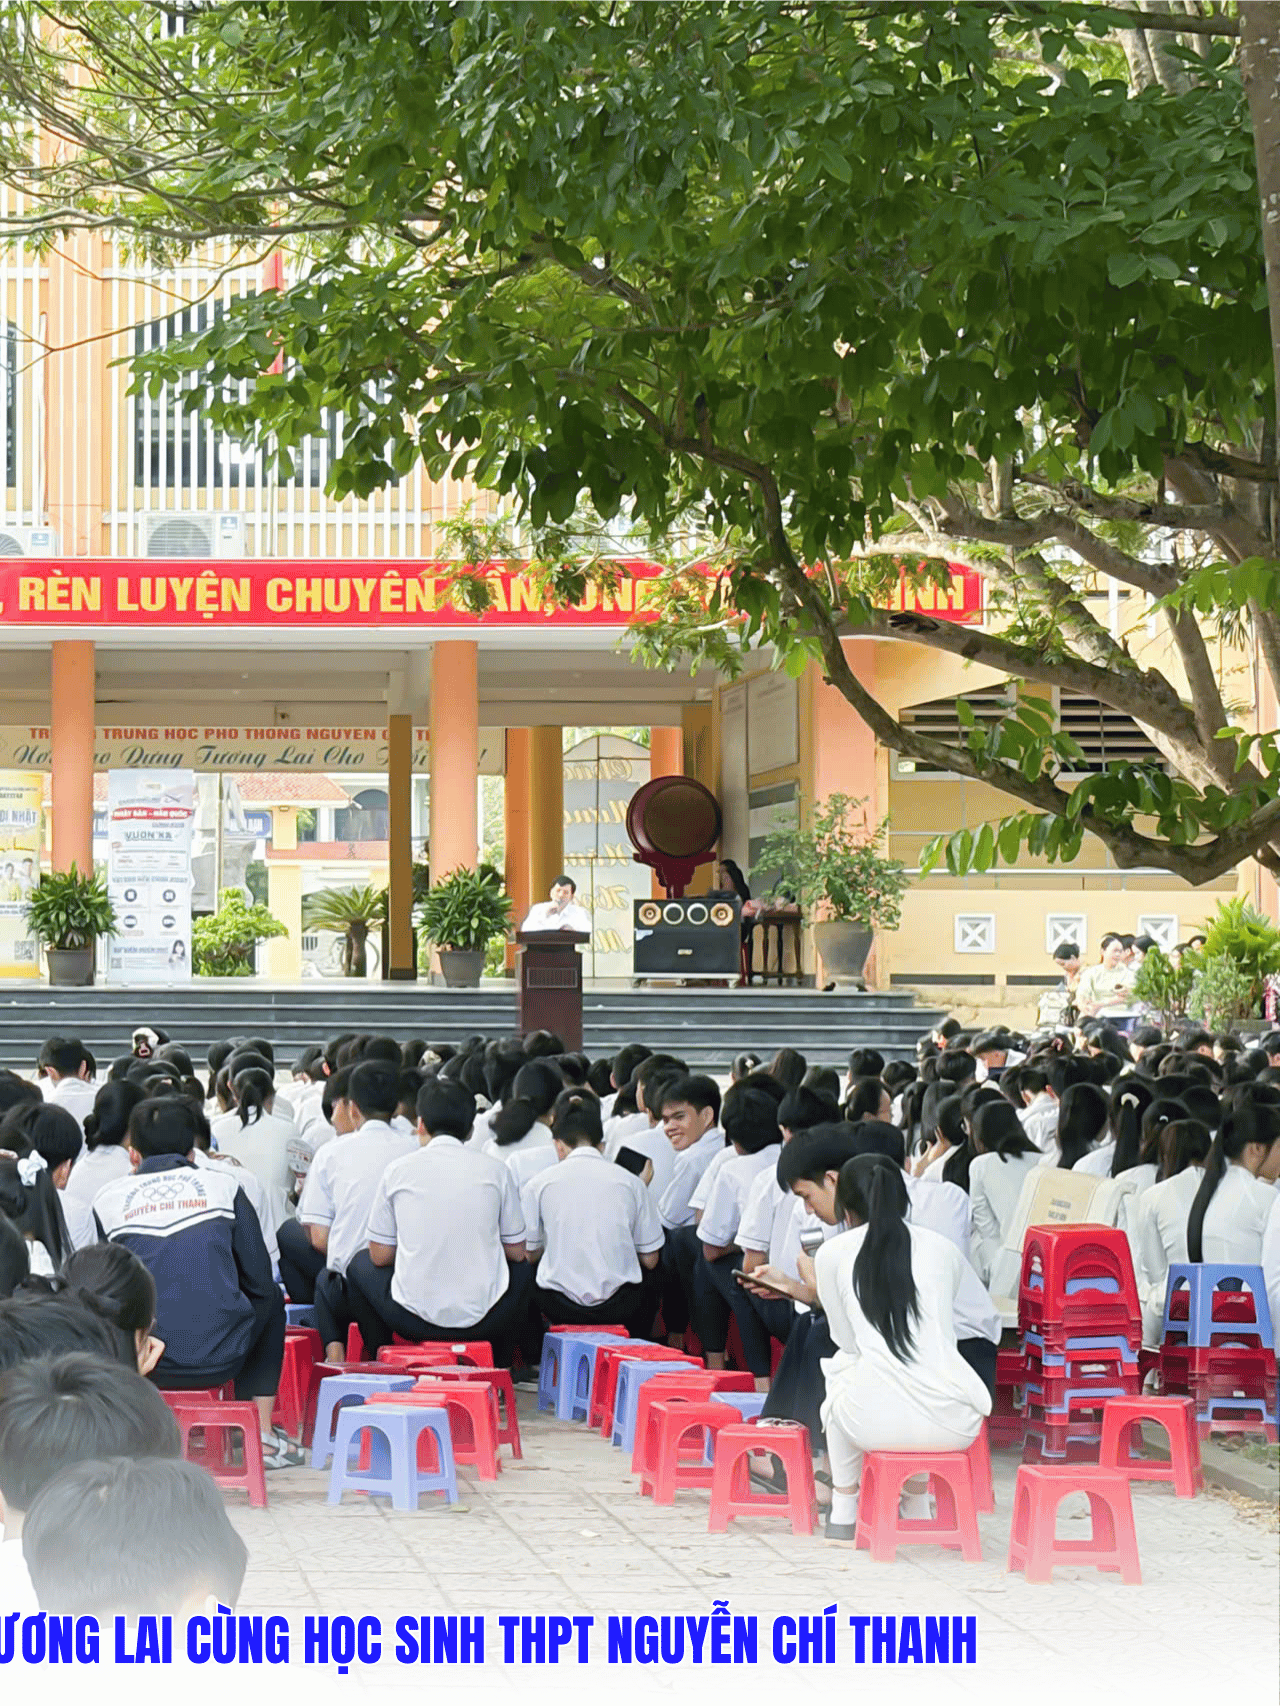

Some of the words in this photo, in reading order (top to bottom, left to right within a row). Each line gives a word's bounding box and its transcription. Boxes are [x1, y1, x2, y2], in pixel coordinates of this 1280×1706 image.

[18, 569, 101, 611] RÈN
[117, 570, 251, 618] LUYỆN
[266, 570, 437, 612] CHUYÊN
[103, 727, 159, 740] TRUNG
[273, 745, 316, 765] Lai
[323, 745, 365, 765] Cho
[178, 1198, 208, 1209] THANH
